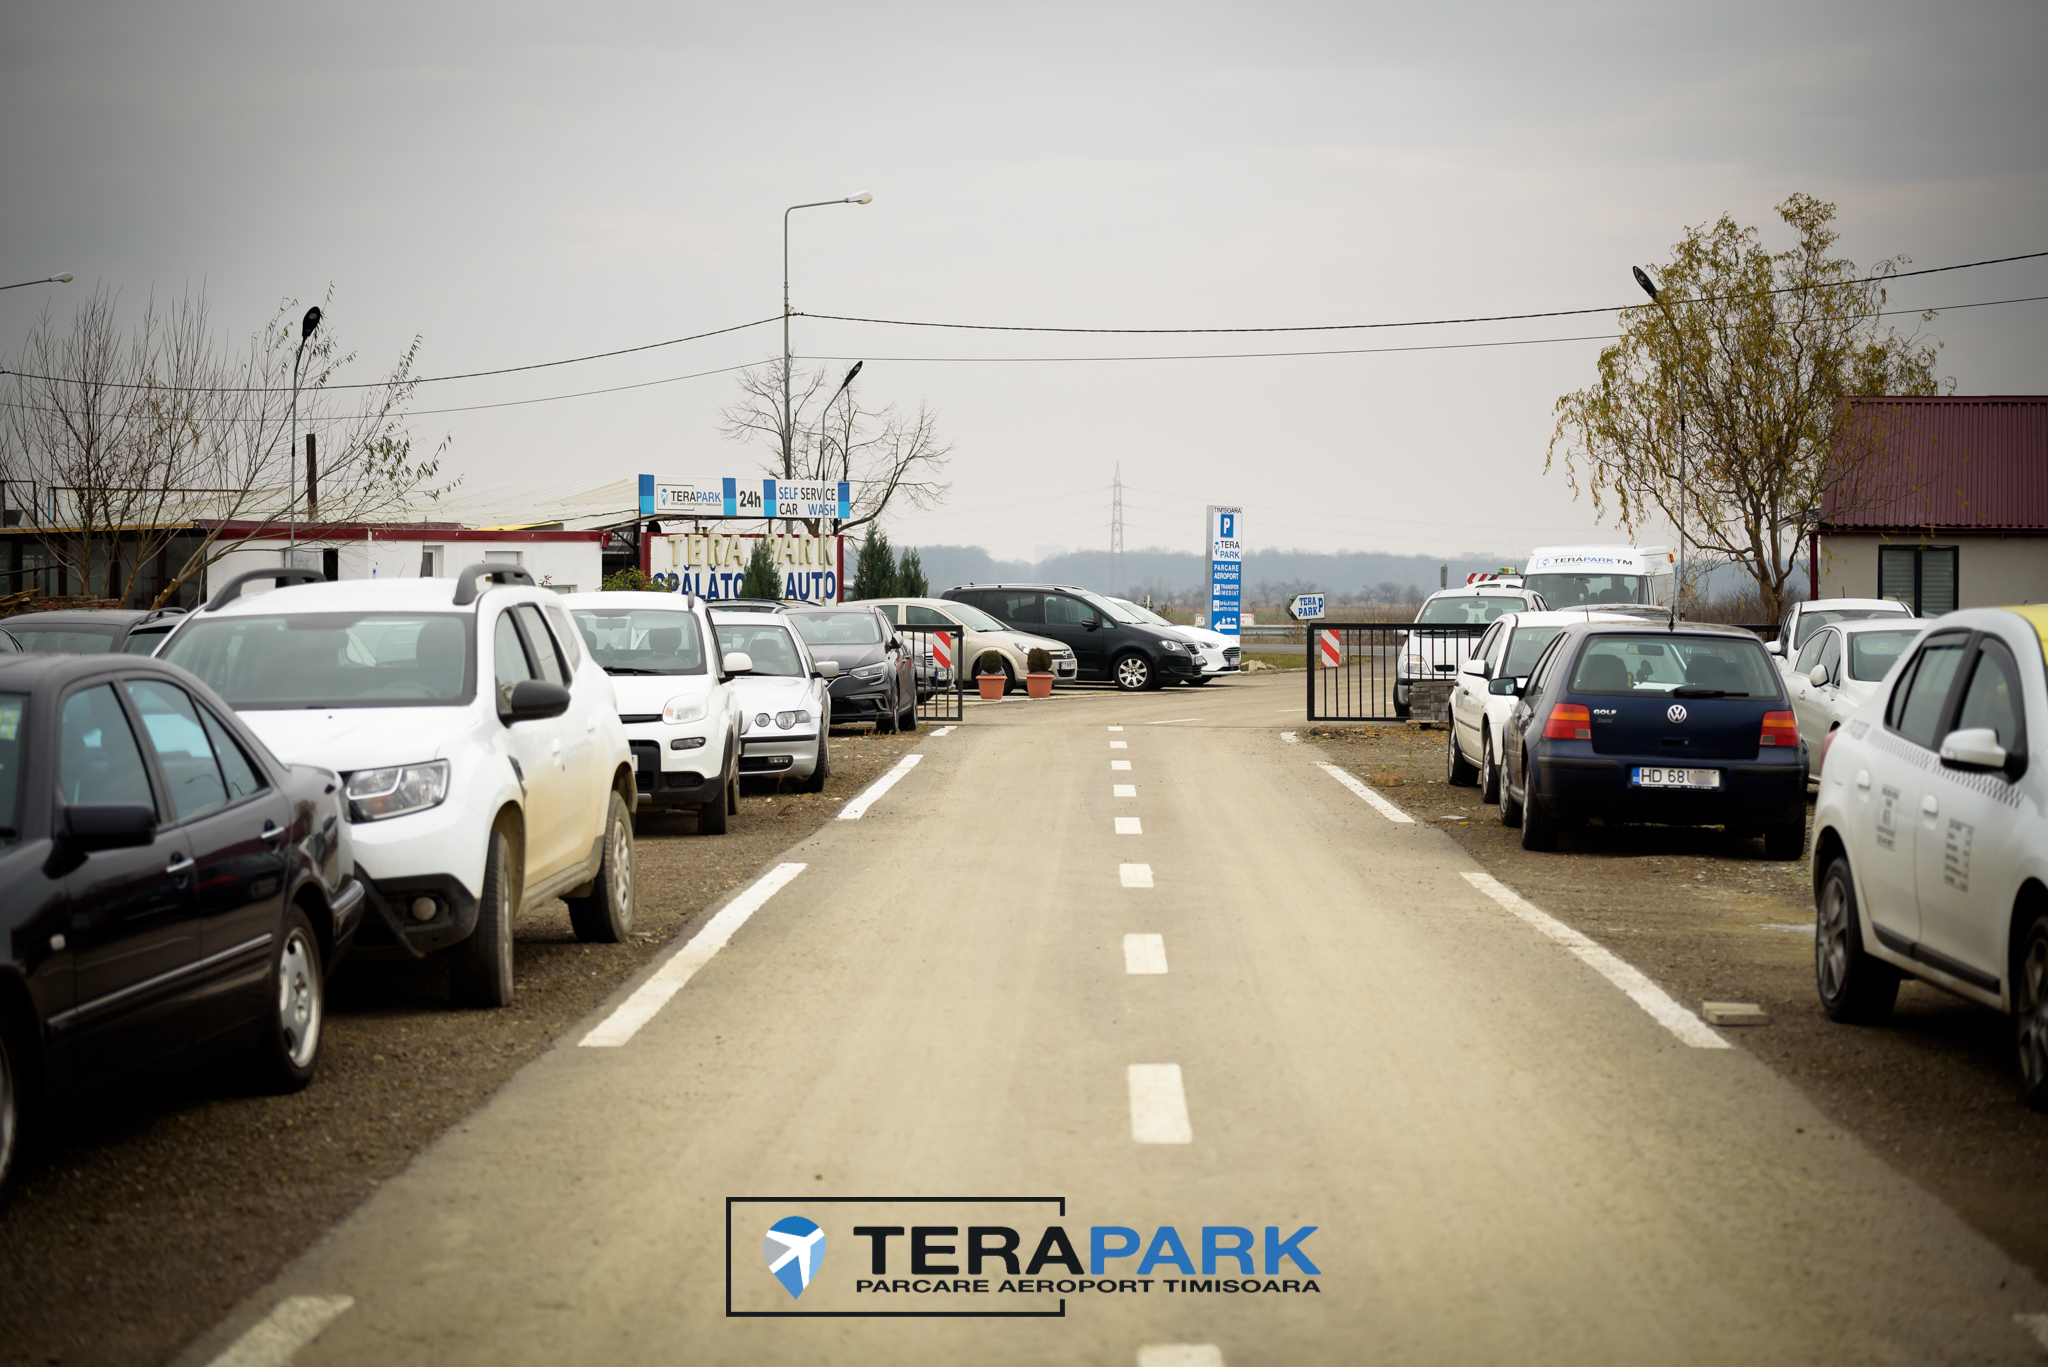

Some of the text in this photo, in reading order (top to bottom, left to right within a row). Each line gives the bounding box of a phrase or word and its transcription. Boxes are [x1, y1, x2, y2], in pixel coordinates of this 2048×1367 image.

[670, 490, 722, 503] TERAPARK
[739, 490, 761, 508] 24h
[778, 486, 836, 501] SELF SERVCE
[779, 502, 836, 516] CAR WASH
[1223, 517, 1231, 534] P
[667, 533, 836, 566] TERA PARK
[1220, 540, 1240, 549] TERA
[1220, 550, 1240, 559] PARK
[1553, 556, 1633, 566] TERAPARK TM
[1213, 564, 1239, 572] PARCARE
[1213, 572, 1239, 580] AEROPORT
[784, 570, 836, 600] AUTO
[1298, 596, 1324, 613] TERA P
[1298, 606, 1318, 617] PARK
[1641, 768, 1663, 784] HD
